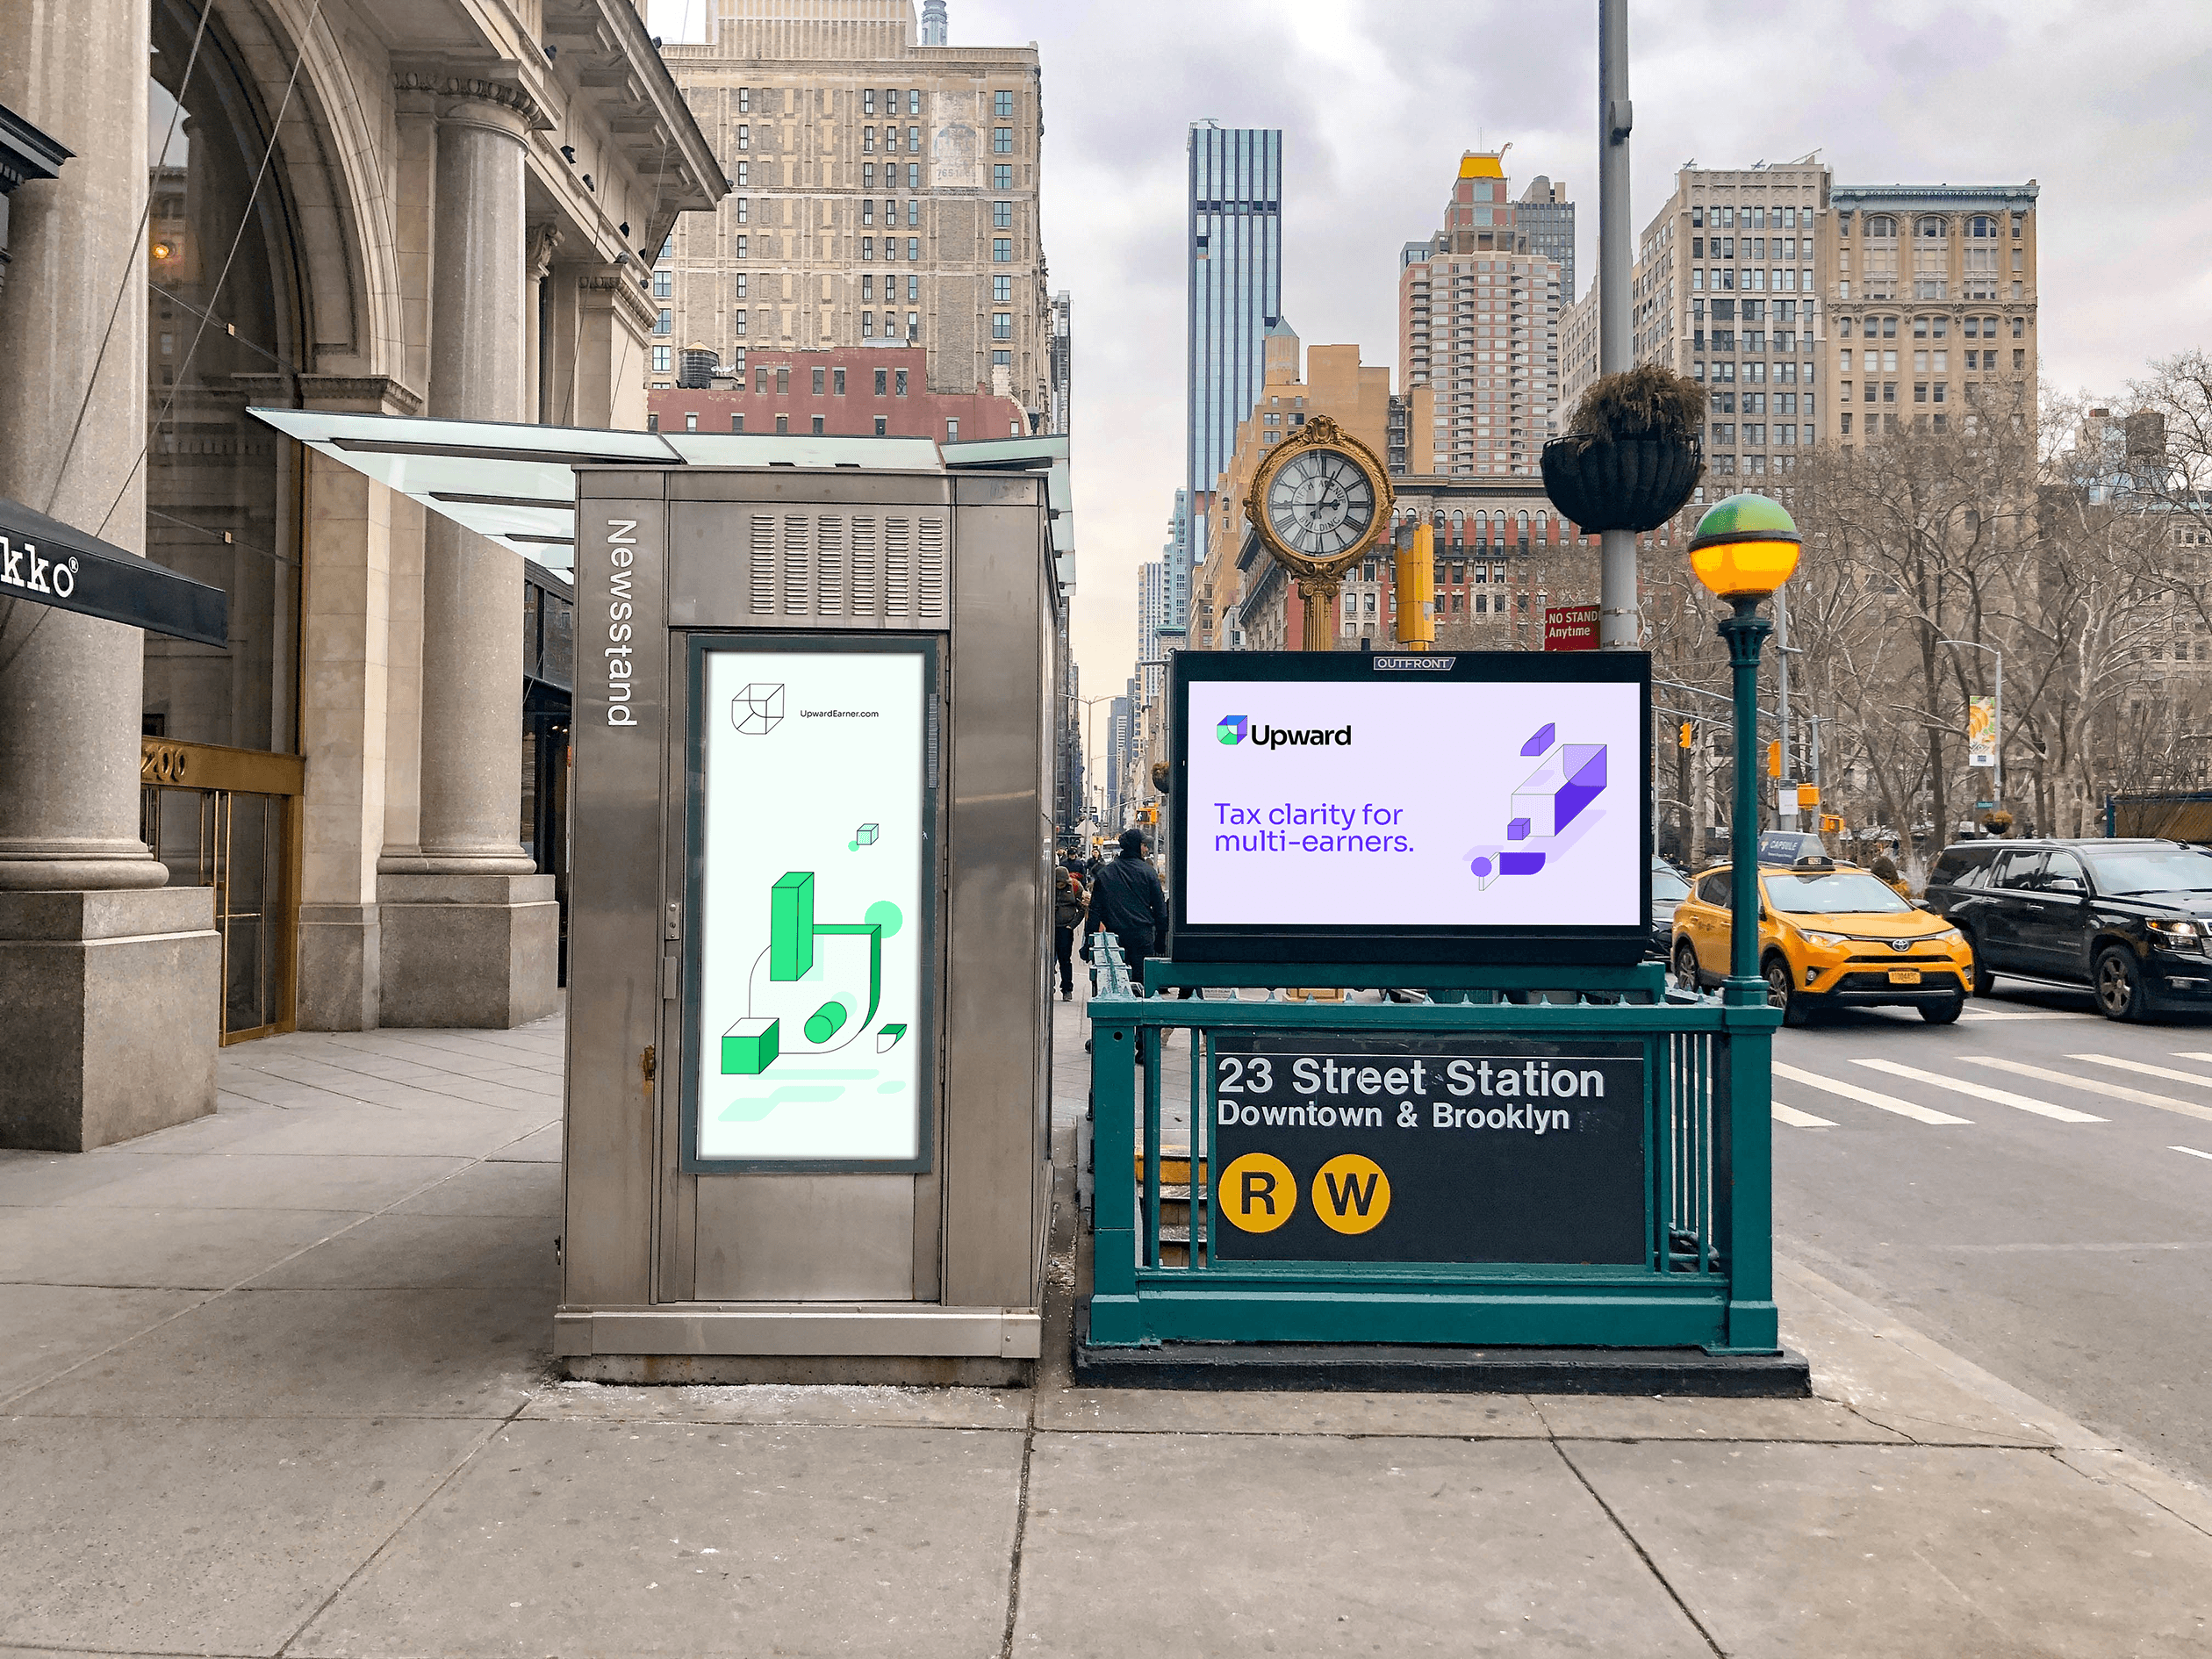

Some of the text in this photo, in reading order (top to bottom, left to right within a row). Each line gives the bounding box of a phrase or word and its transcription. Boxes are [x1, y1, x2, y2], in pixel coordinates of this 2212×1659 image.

[1295, 480, 1346, 504] FIFTH ANUE
[1298, 516, 1340, 532] BUILDING
[604, 519, 637, 726] Newsstand
[1548, 613, 1563, 624] NO
[1548, 625, 1591, 640] Anytime
[1377, 658, 1449, 669] OUTFRONT
[800, 709, 880, 719] UpwardEarner.com
[1251, 725, 1352, 750] Upward
[1214, 802, 1404, 830] Tax clarity for
[1215, 830, 1414, 852] multi-earners.
[1217, 1057, 1605, 1098] 23 Street Station
[1217, 1100, 1569, 1135] Downtown & Brooklyn
[1240, 1171, 1276, 1215] R
[1324, 1172, 1379, 1217] W
